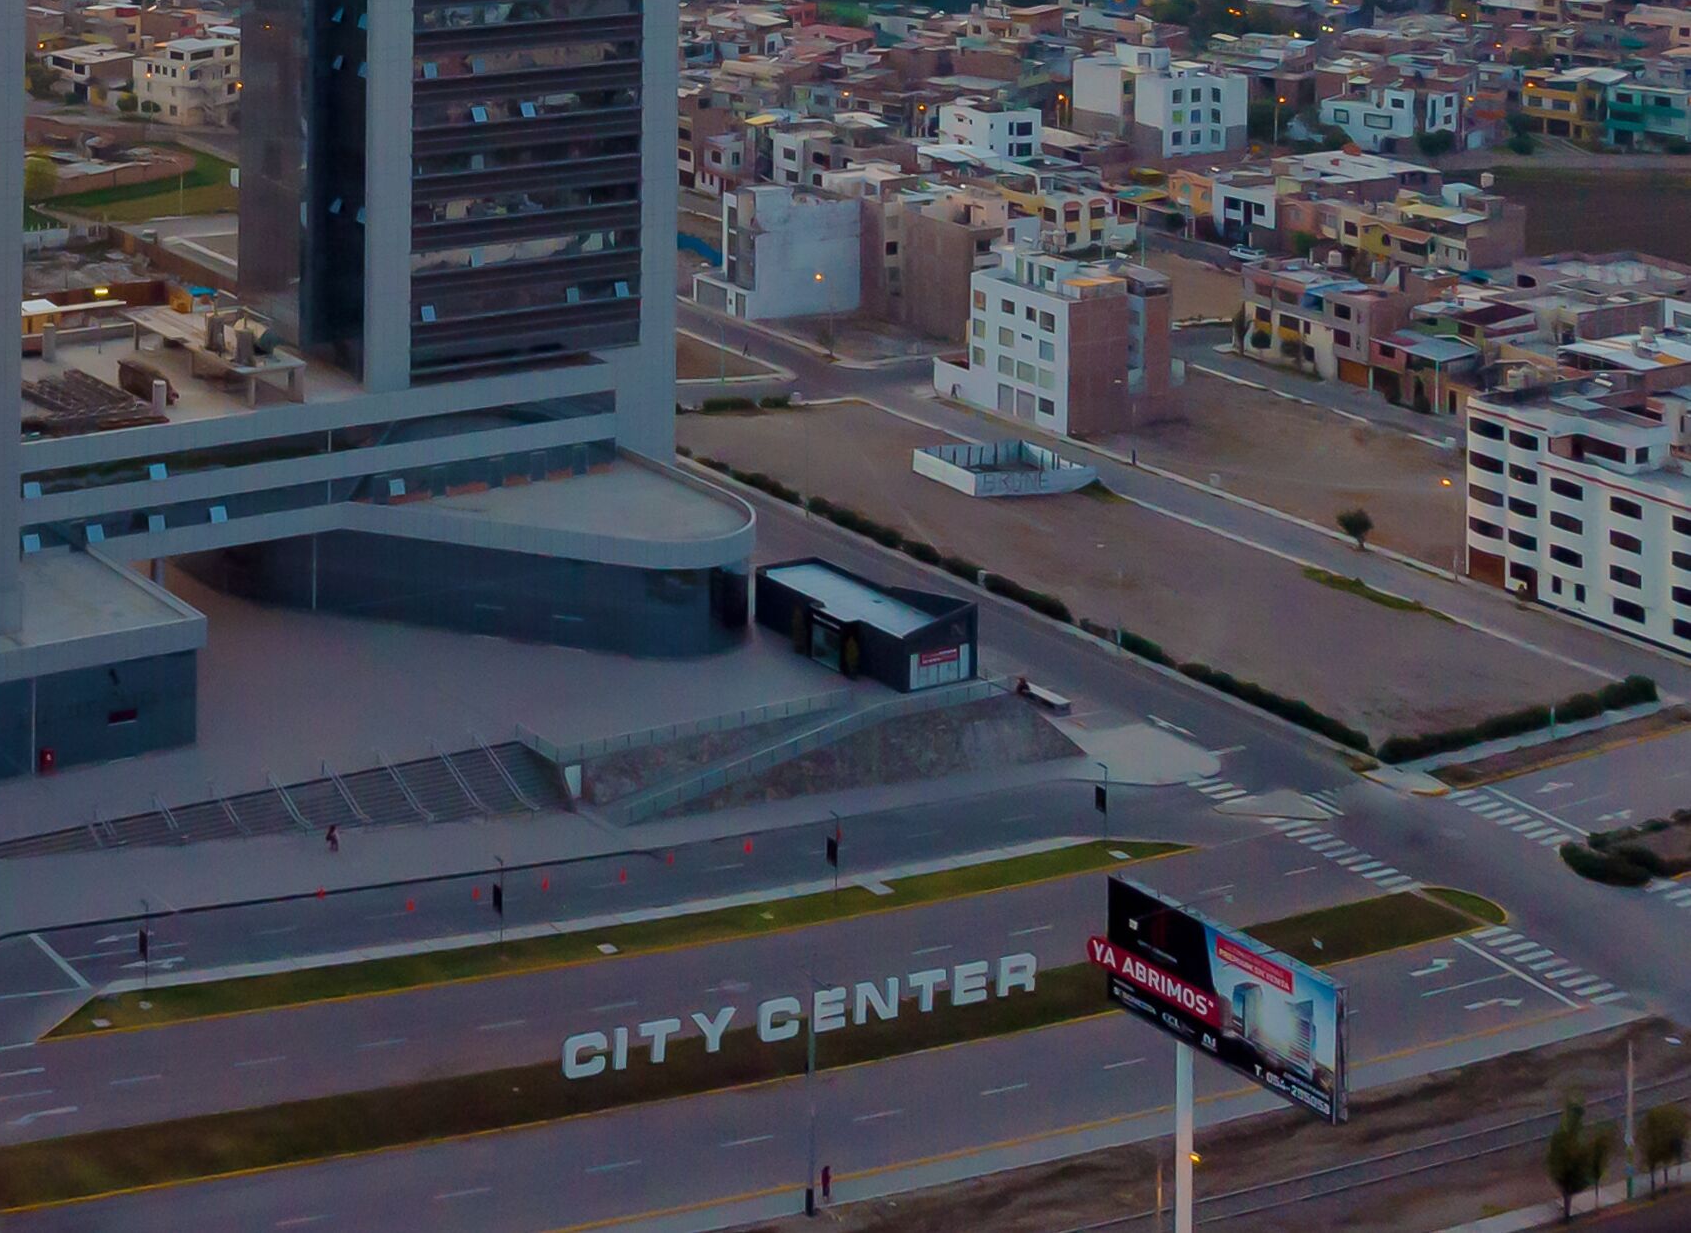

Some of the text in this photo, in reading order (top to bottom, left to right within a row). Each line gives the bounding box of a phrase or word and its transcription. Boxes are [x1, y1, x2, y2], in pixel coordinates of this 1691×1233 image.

[1092, 938, 1117, 969] YA
[560, 952, 1037, 1081] CITY CENTER
